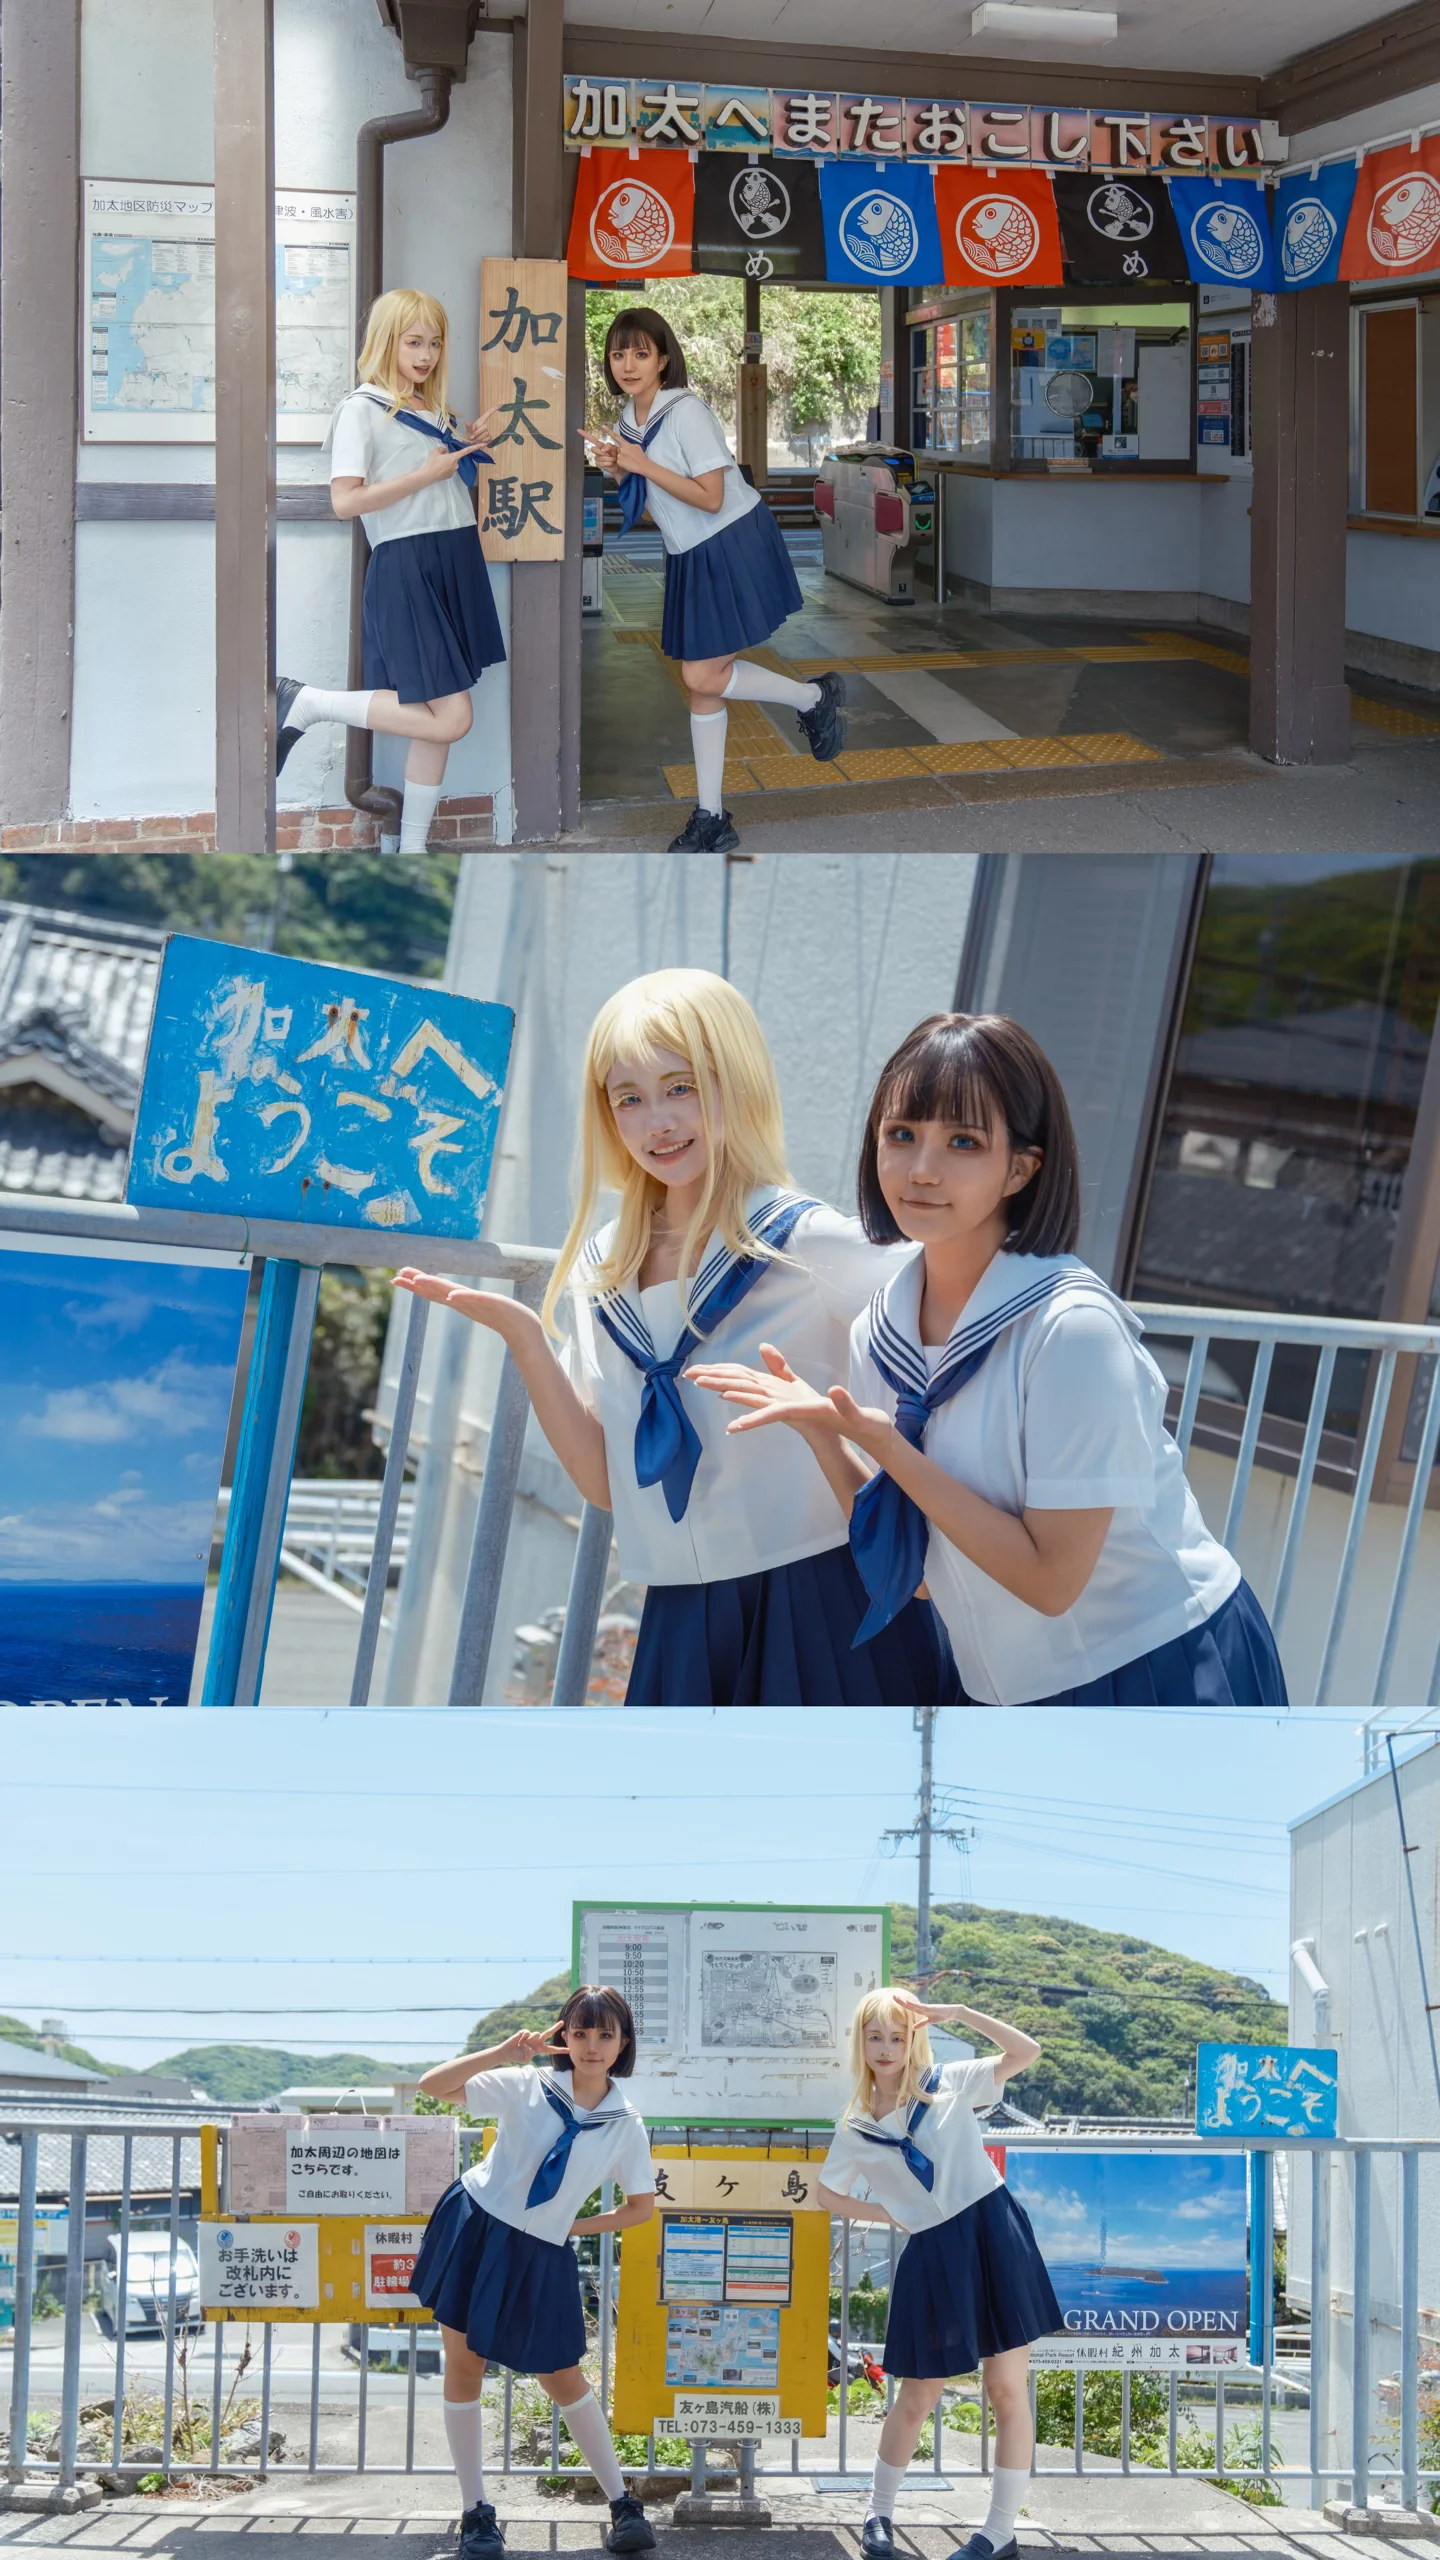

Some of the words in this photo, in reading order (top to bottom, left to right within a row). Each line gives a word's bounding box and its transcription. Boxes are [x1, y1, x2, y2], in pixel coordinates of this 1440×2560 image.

[570, 79, 1265, 168] 加太へまたおこし下さい
[92, 199, 213, 213] 加太地区防災マップ
[745, 250, 774, 281] め
[1122, 250, 1149, 278] め
[481, 286, 564, 540] 加太駅
[208, 974, 495, 1100] 加太へ
[160, 1070, 468, 1197] ようこそ
[625, 1943, 642, 1951] 9:00
[625, 1951, 642, 1959] 9:50
[623, 1960, 644, 1968] 10:20
[623, 1968, 644, 1976] 10:50
[623, 1977, 644, 1985] 11:55
[623, 1985, 644, 1993] 12:55
[1217, 2053, 1333, 2088] 加太へ
[1207, 2087, 1325, 2127] ようこそ
[290, 2146, 400, 2160] 加太周辺の地図は
[291, 2163, 359, 2177] こちらです。
[298, 2190, 392, 2200] ご自由にお取りください。
[376, 2232, 412, 2244] 休暇村
[218, 2248, 299, 2263] お手洗いは
[226, 2265, 291, 2281] 改札内に
[218, 2283, 300, 2299] ございます。
[1063, 2310, 1160, 2333] GRAND
[1167, 2310, 1239, 2333] OPEN
[659, 2420, 800, 2434] TEL:073-459-1333
